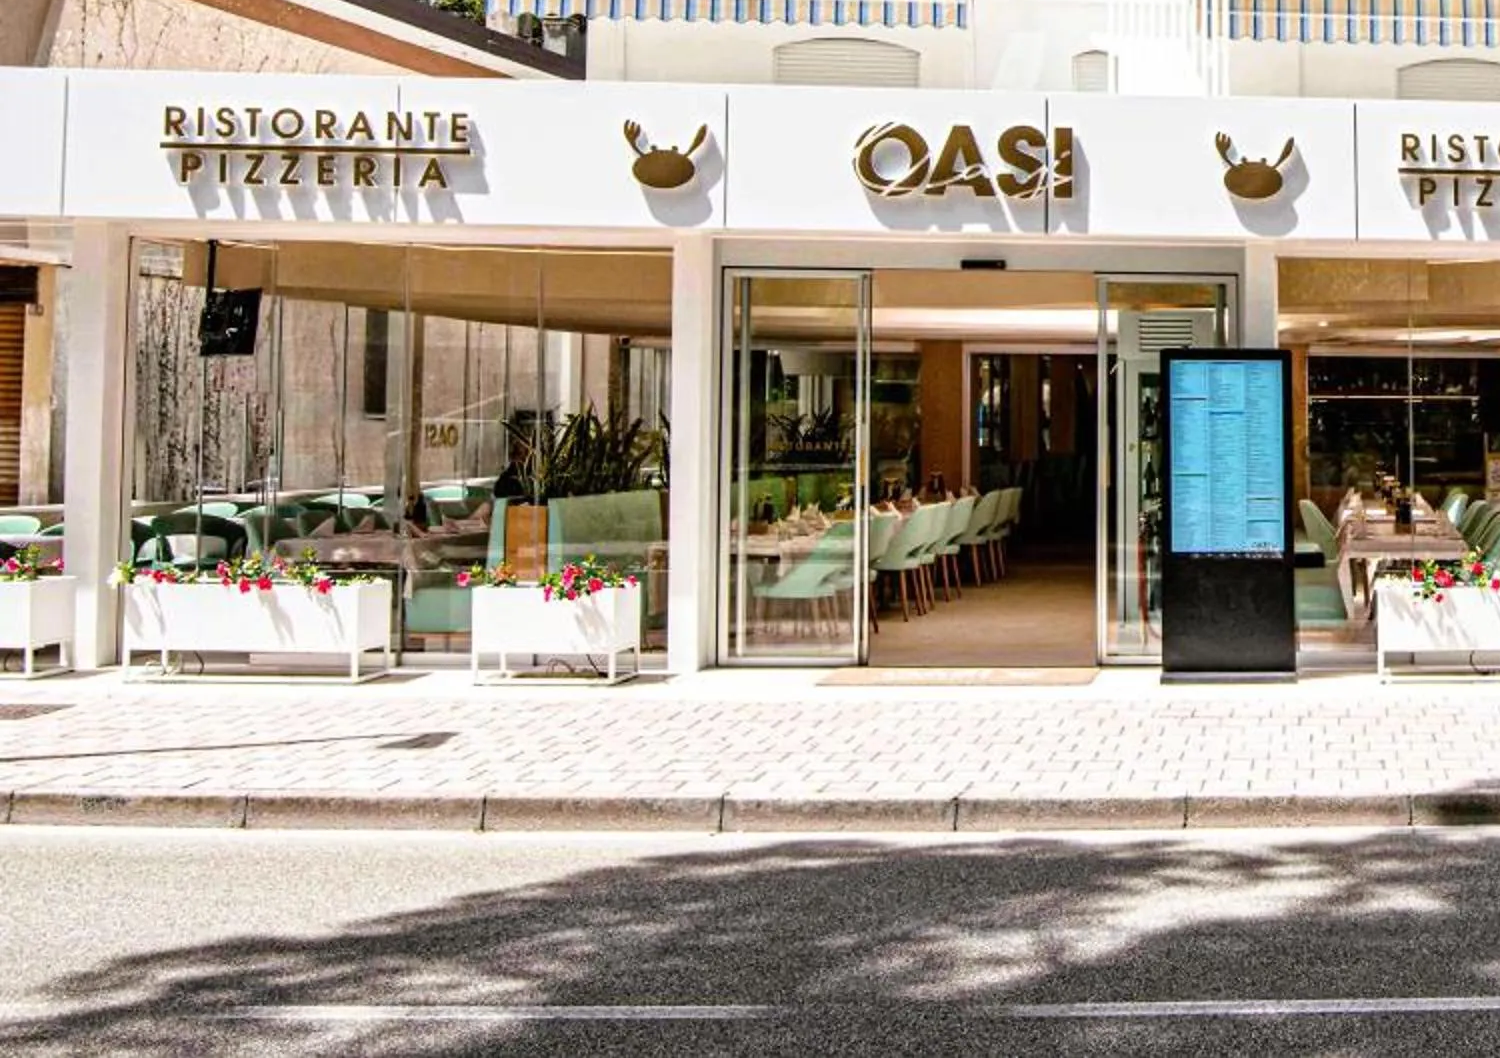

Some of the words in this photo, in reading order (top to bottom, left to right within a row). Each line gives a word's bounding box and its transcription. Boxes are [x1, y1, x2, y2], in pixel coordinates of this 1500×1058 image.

[163, 106, 470, 143] RISTORANTE
[180, 152, 448, 189] PIZZERIA
[852, 122, 1073, 199] OASI
